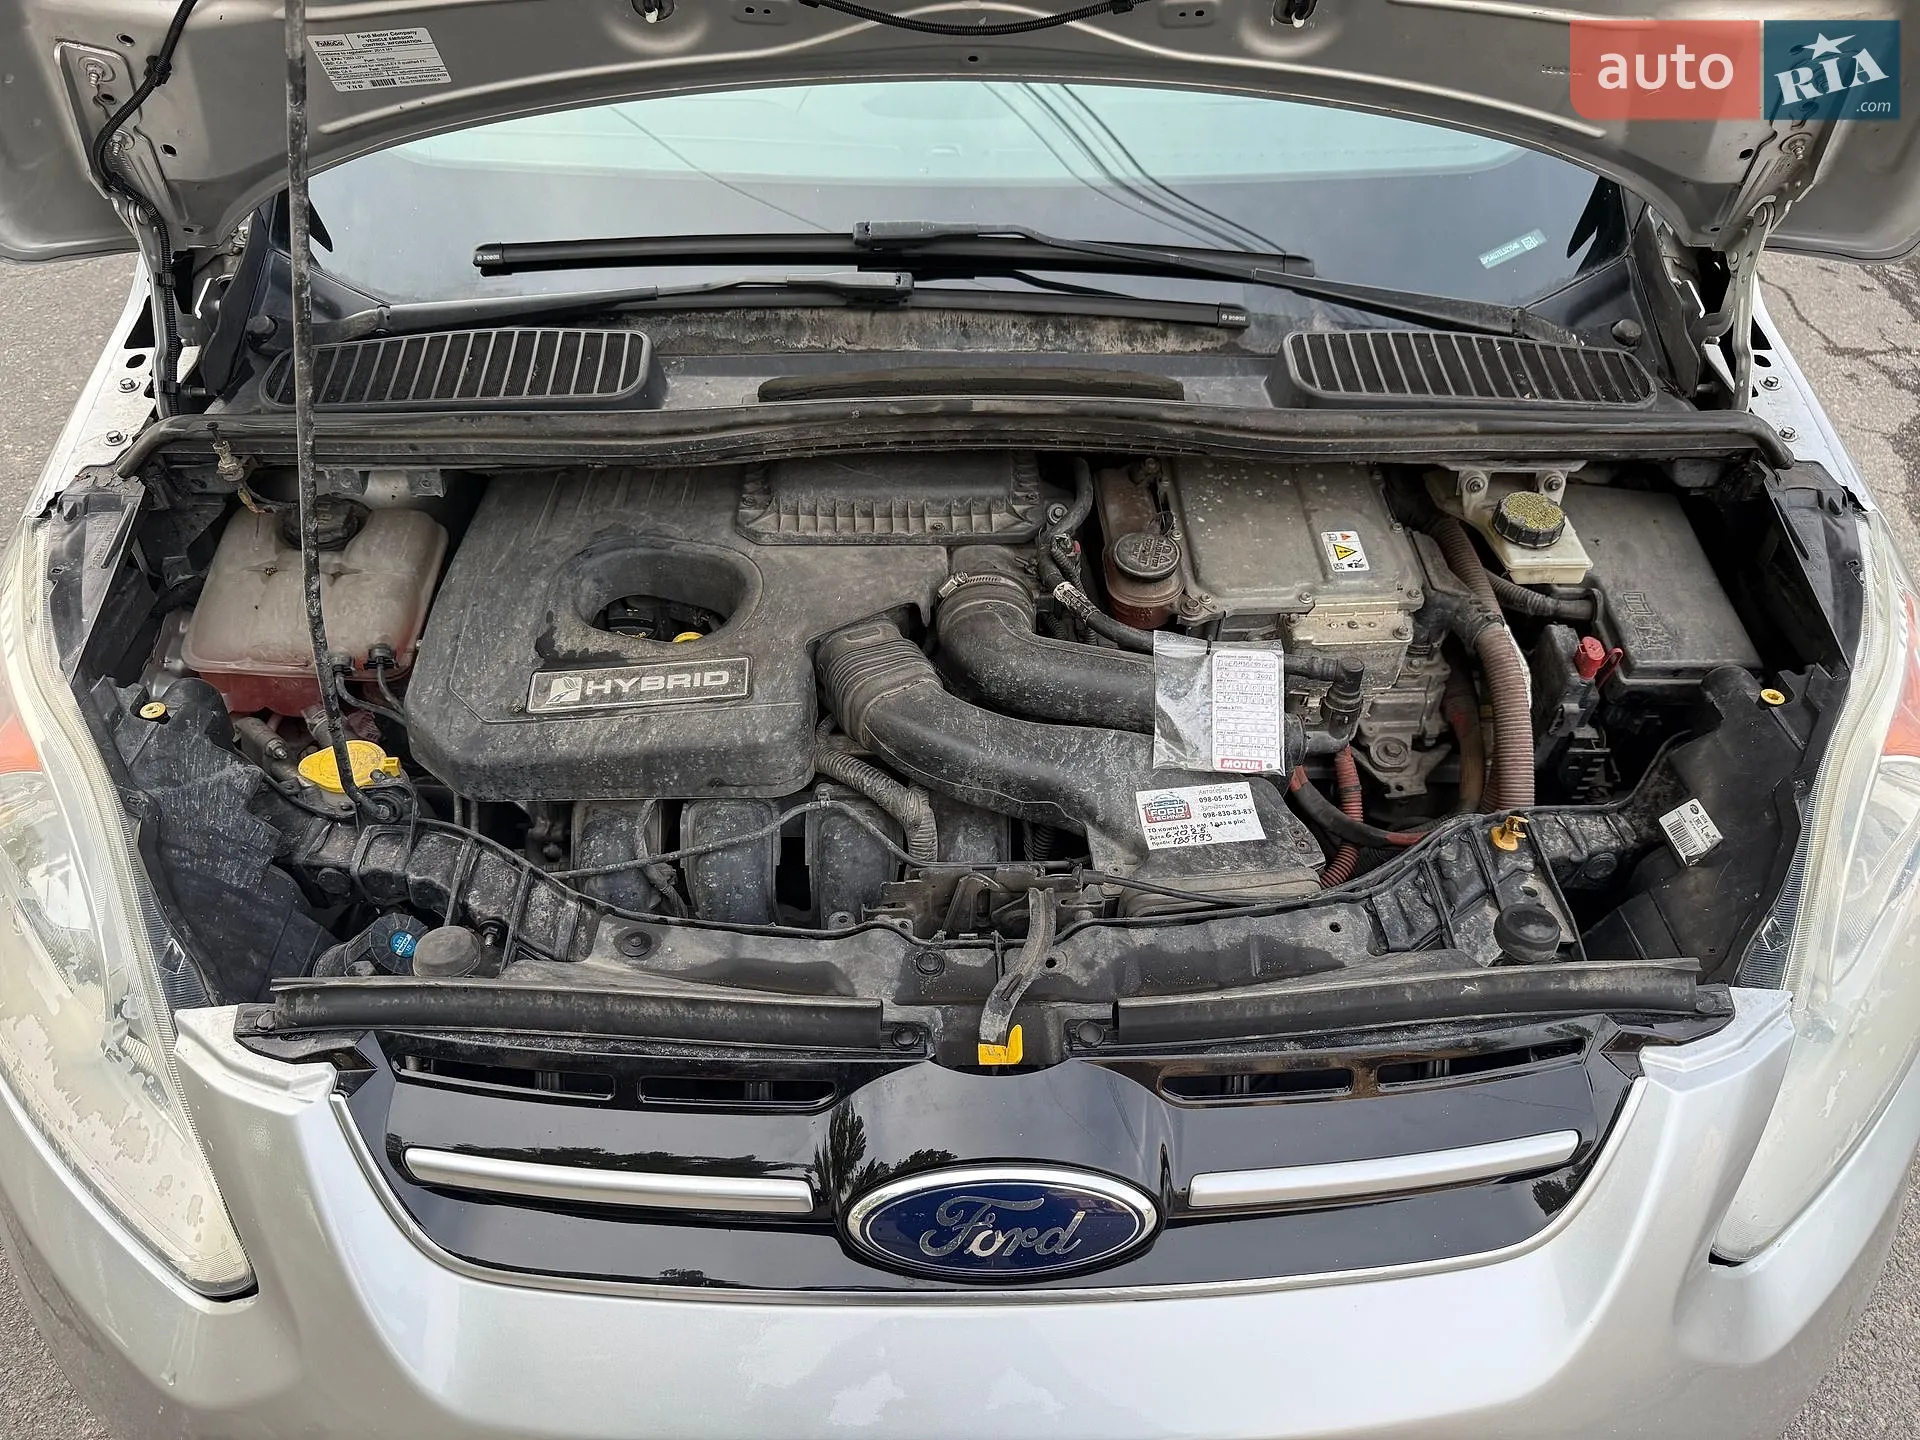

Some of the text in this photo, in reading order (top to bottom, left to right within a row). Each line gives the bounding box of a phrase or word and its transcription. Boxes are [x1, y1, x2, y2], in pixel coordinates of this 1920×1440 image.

[586, 670, 729, 696] HYBRID
[1222, 760, 1261, 770] MOTUL
[1199, 793, 1248, 803] 098-05-05-205
[1151, 807, 1185, 817] FORD
[919, 1195, 1085, 1257] Ford
